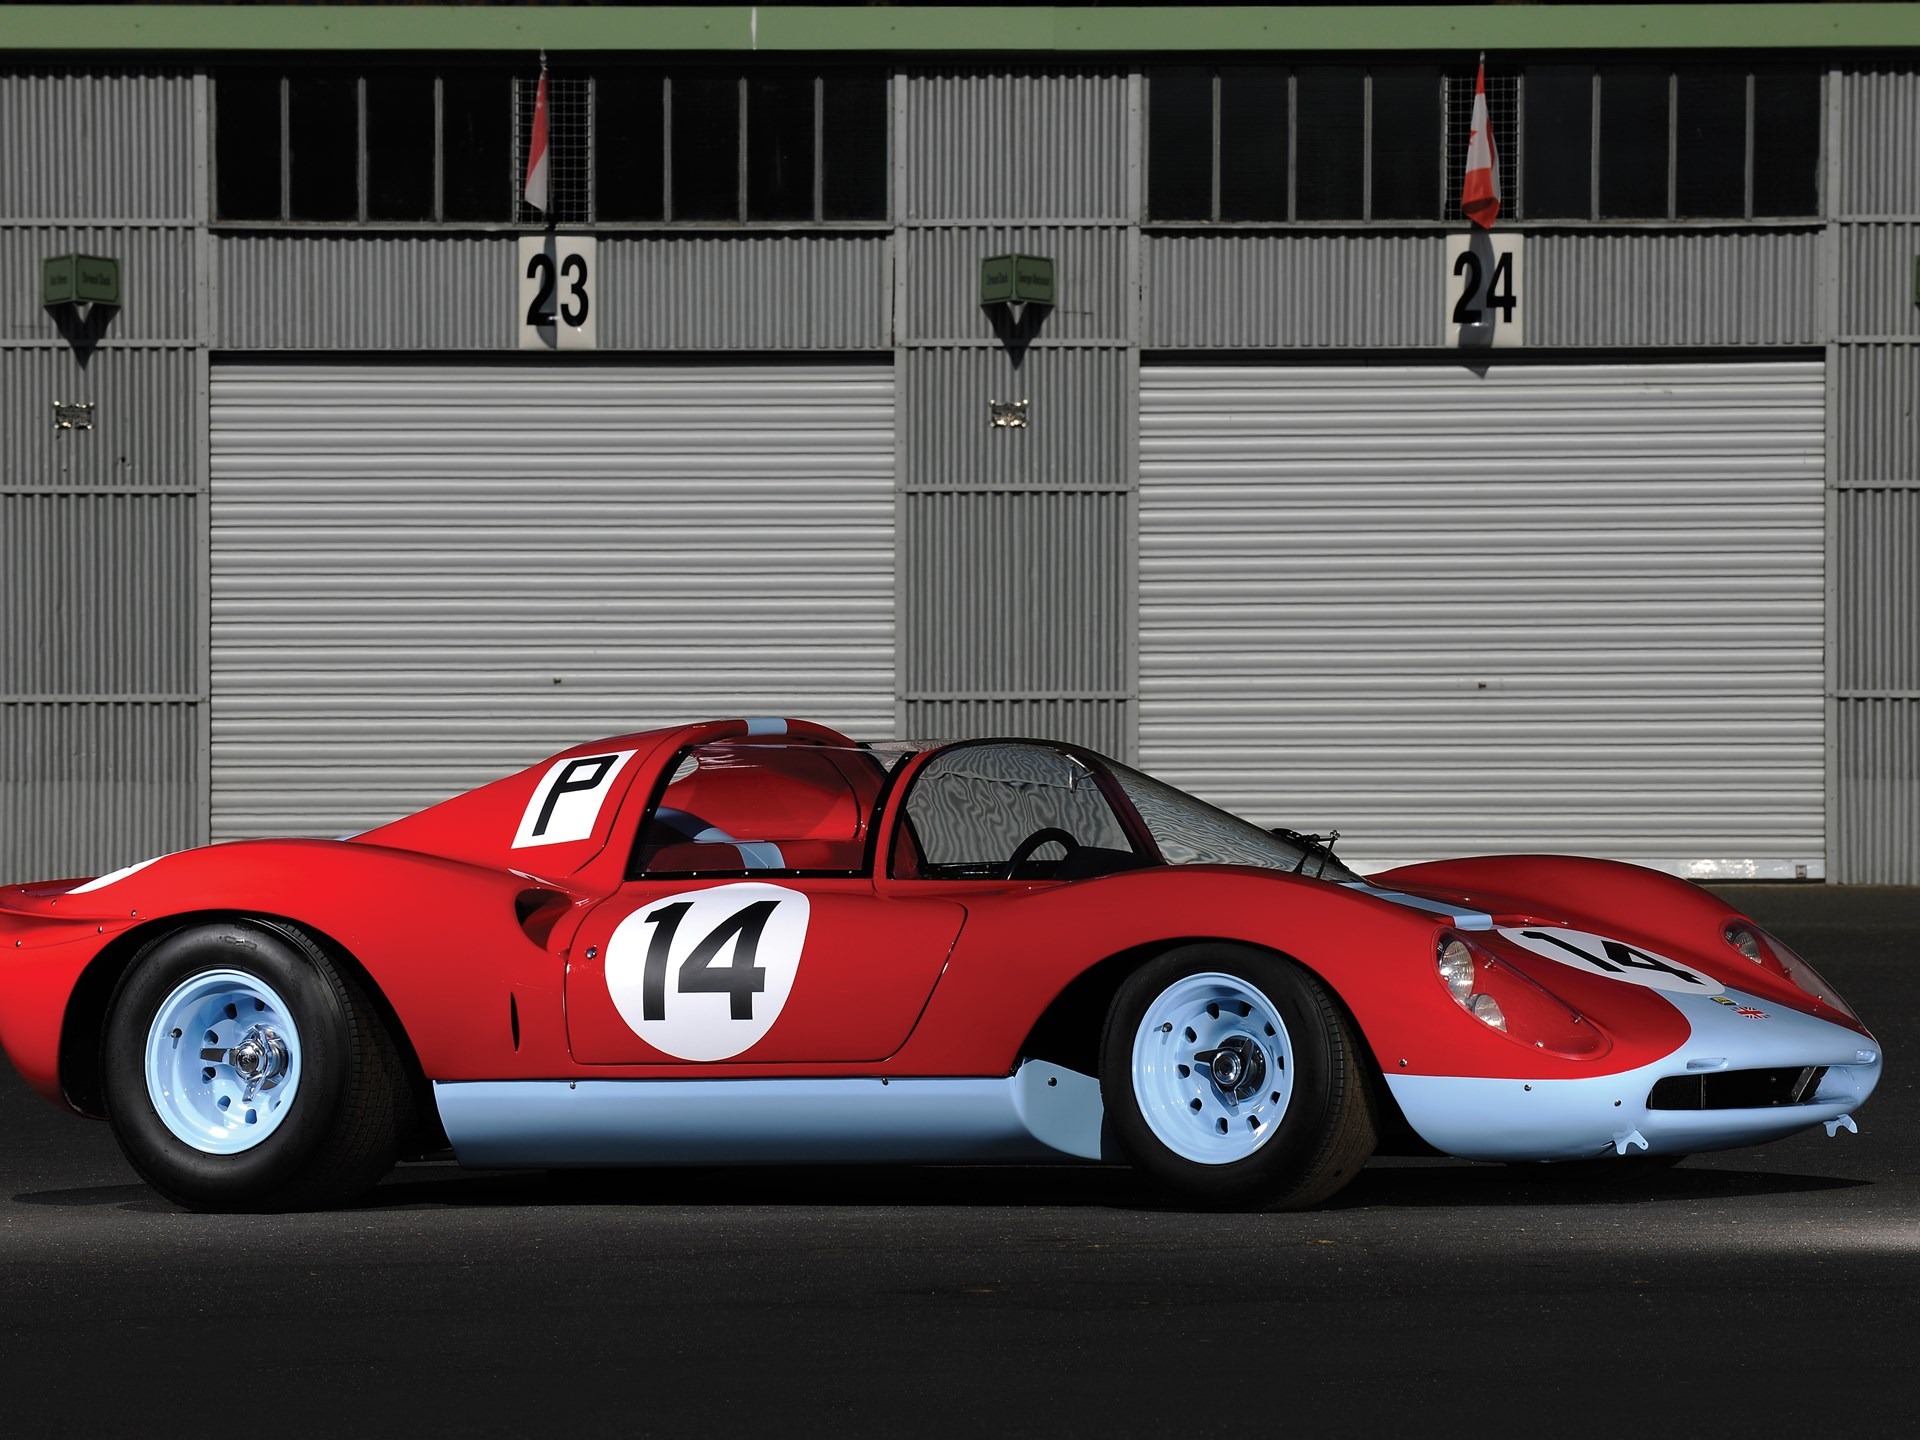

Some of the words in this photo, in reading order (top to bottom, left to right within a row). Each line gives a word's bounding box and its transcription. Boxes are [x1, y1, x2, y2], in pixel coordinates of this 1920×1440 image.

[527, 253, 588, 327] 23
[1452, 251, 1516, 323] 24
[532, 754, 619, 836] P
[643, 900, 782, 1021] 14
[1519, 930, 1706, 986] 14
